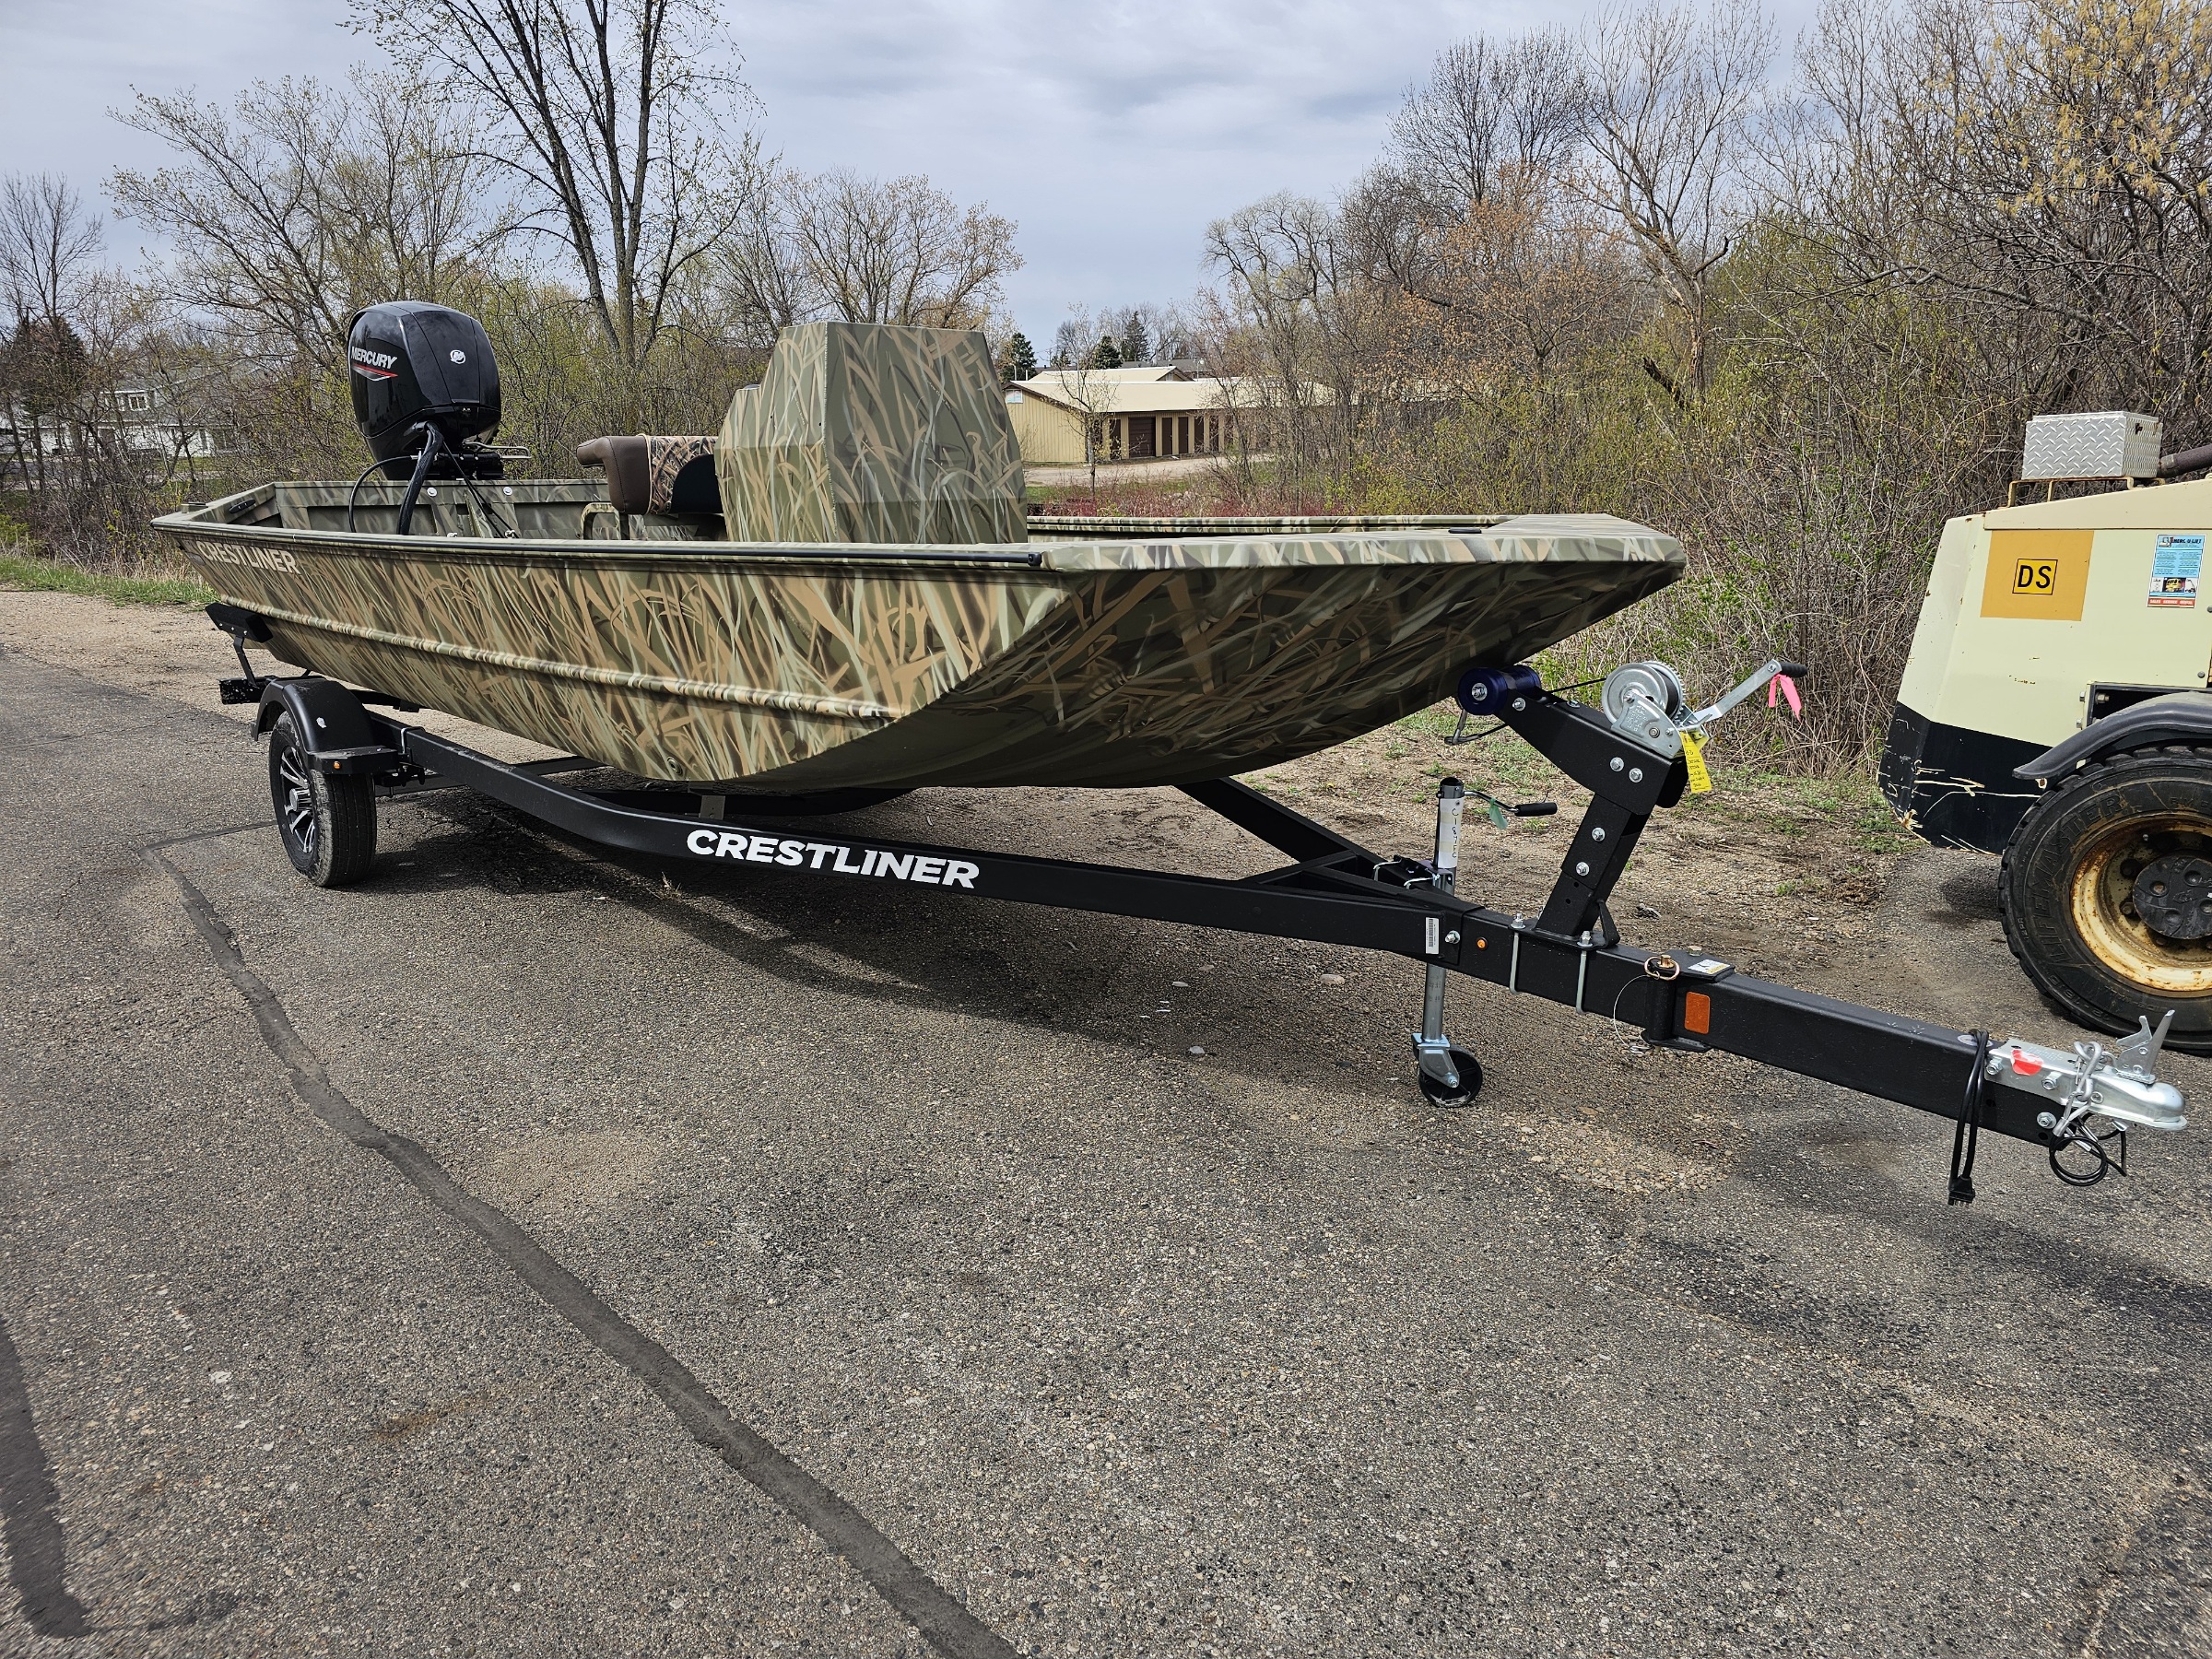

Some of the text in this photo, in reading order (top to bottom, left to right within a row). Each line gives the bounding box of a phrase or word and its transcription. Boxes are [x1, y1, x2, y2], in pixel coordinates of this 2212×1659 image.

[350, 346, 398, 370] MERCURY
[196, 540, 301, 575] CRESTLINER
[2017, 564, 2053, 590] DS
[686, 829, 981, 889] CRESTLINER
